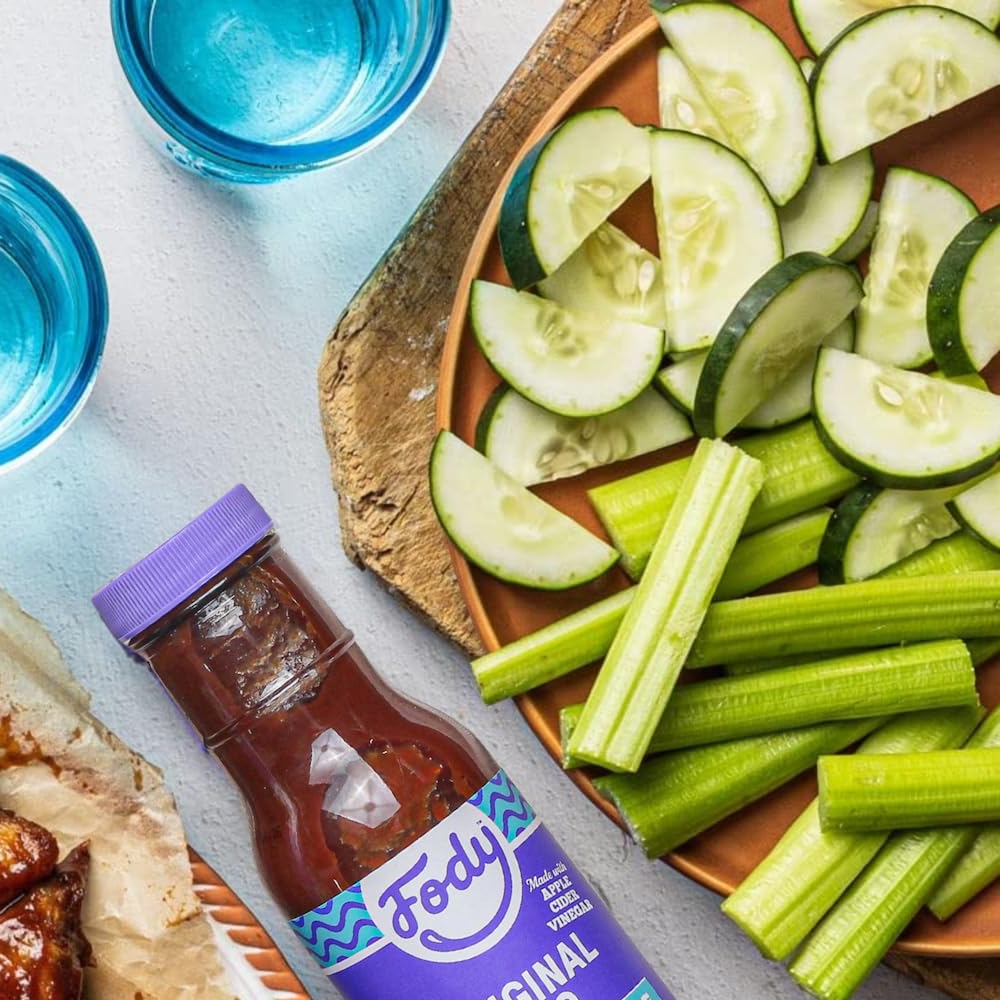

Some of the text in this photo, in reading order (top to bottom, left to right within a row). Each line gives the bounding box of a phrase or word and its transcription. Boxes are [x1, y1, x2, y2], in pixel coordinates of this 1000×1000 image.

[378, 825, 512, 952] Fody
[526, 860, 568, 892] Made with
[540, 875, 573, 901] APPLE
[546, 898, 594, 932] VINEGAR
[549, 889, 581, 913] CIDER
